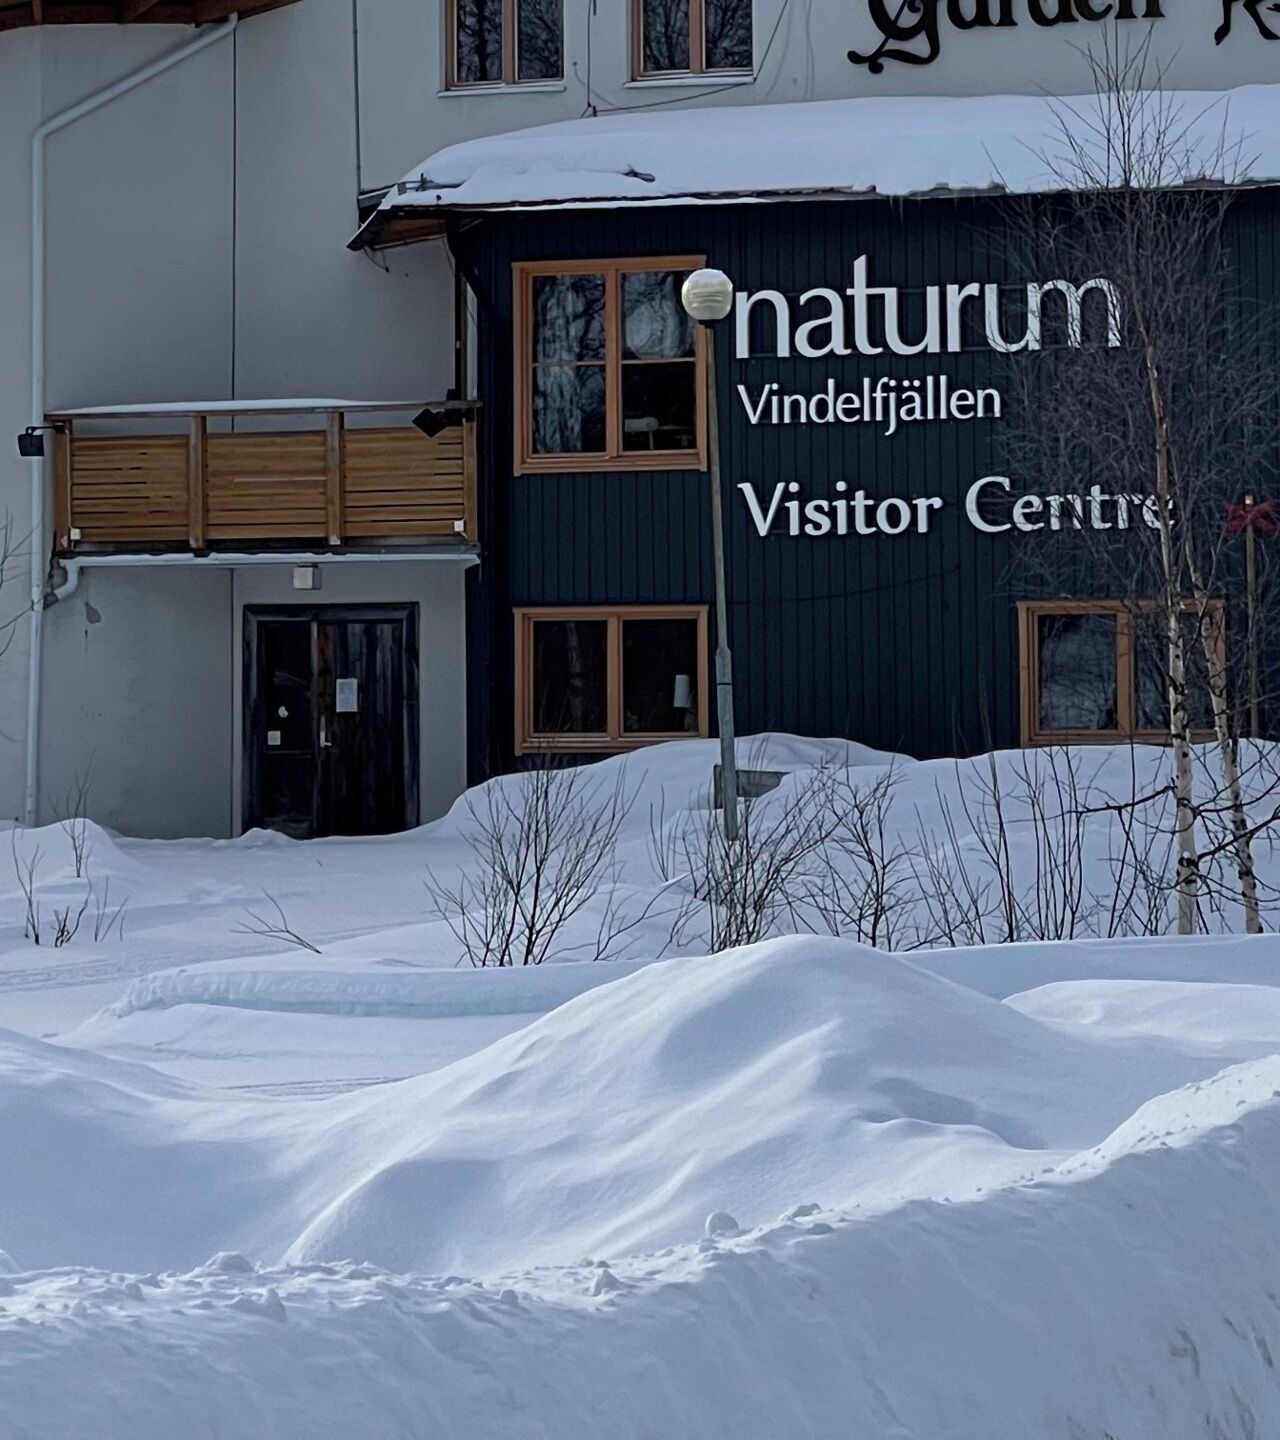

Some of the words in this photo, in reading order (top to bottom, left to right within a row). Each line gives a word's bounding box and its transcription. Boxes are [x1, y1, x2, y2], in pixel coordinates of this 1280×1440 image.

[735, 254, 1122, 359] naturum
[737, 375, 1002, 436] Vindelfjällen
[738, 480, 943, 536] Visitor
[965, 476, 1175, 534] Centre
